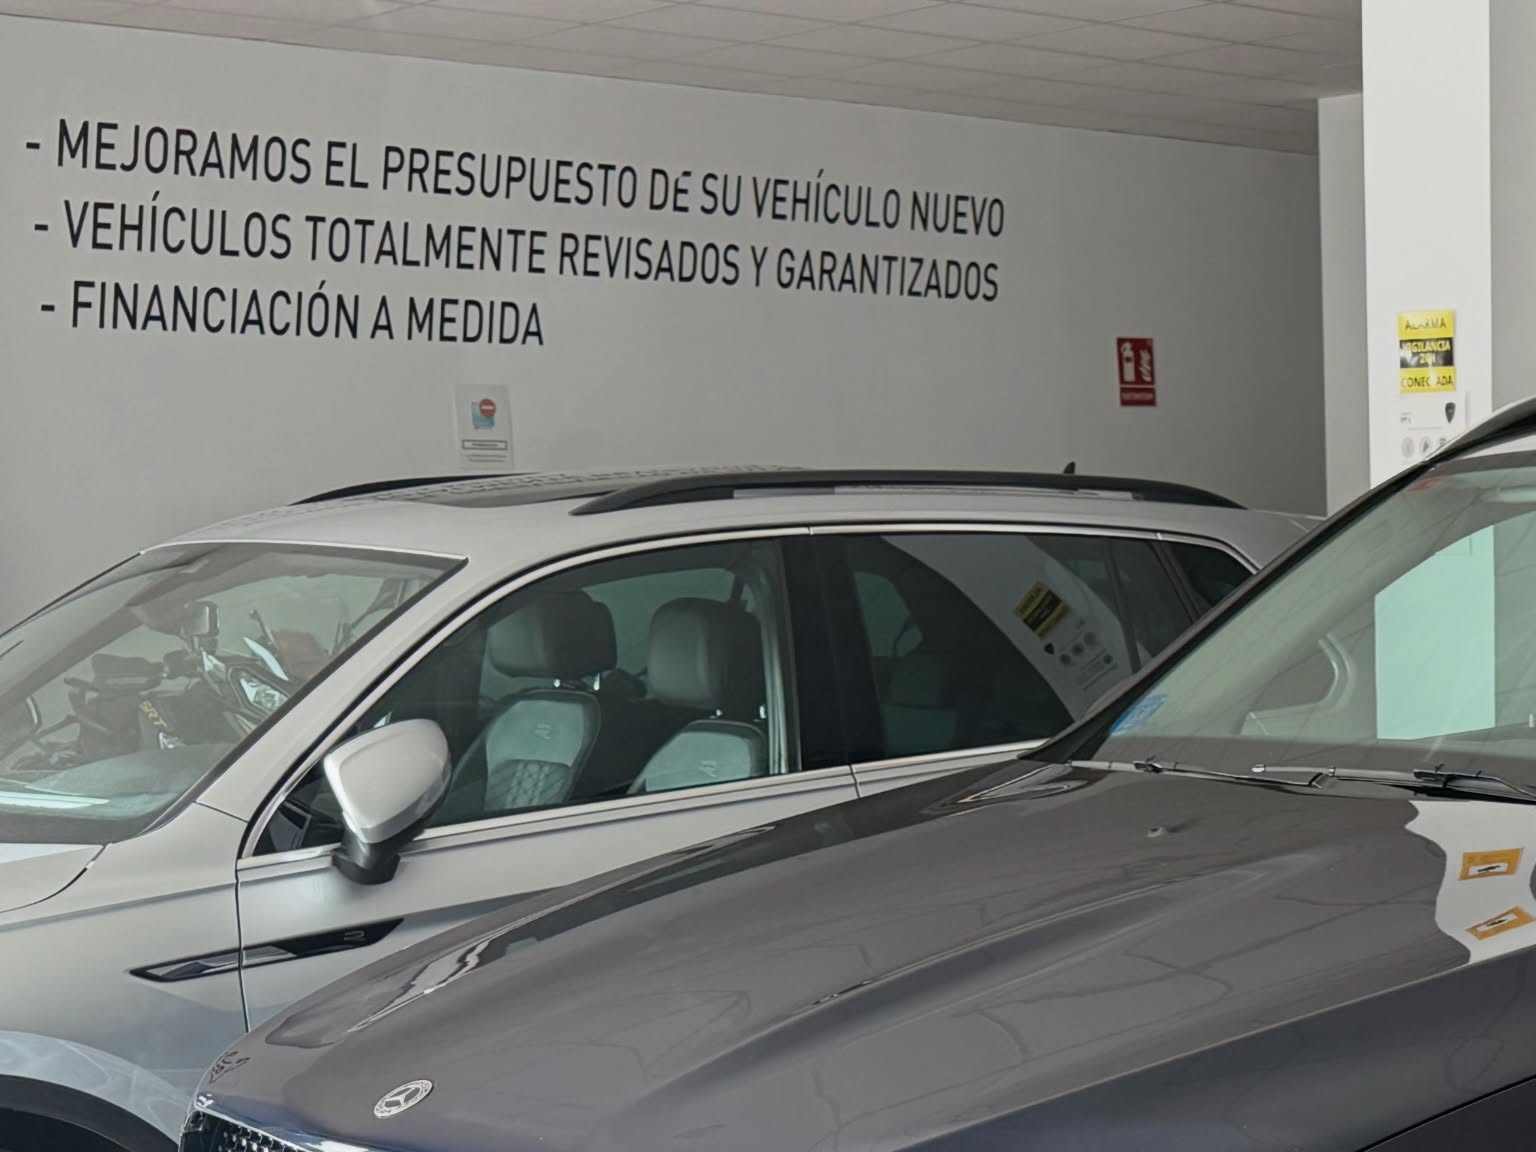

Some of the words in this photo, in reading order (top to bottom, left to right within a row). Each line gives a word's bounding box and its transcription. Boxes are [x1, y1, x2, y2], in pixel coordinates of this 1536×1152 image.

[58, 118, 312, 185] MEJORAMOS
[325, 141, 370, 190] EL
[383, 146, 638, 209] PRESUPUESTO
[649, 168, 693, 214] DE
[700, 173, 742, 217] SU
[752, 168, 901, 230] VEHÍCULO
[911, 191, 1005, 238] NUEVO
[64, 189, 292, 260] VEHÍCULOS
[305, 215, 548, 275] TOTALMENTE
[559, 232, 740, 287] REVISADOS
[750, 246, 768, 288] Y
[777, 248, 999, 303] GARANTIZADOS
[72, 279, 360, 340] FINANCIACIÓN
[370, 295, 395, 341] A
[407, 297, 545, 347] MEDIDA
[1400, 375, 1454, 388] CONECADA
